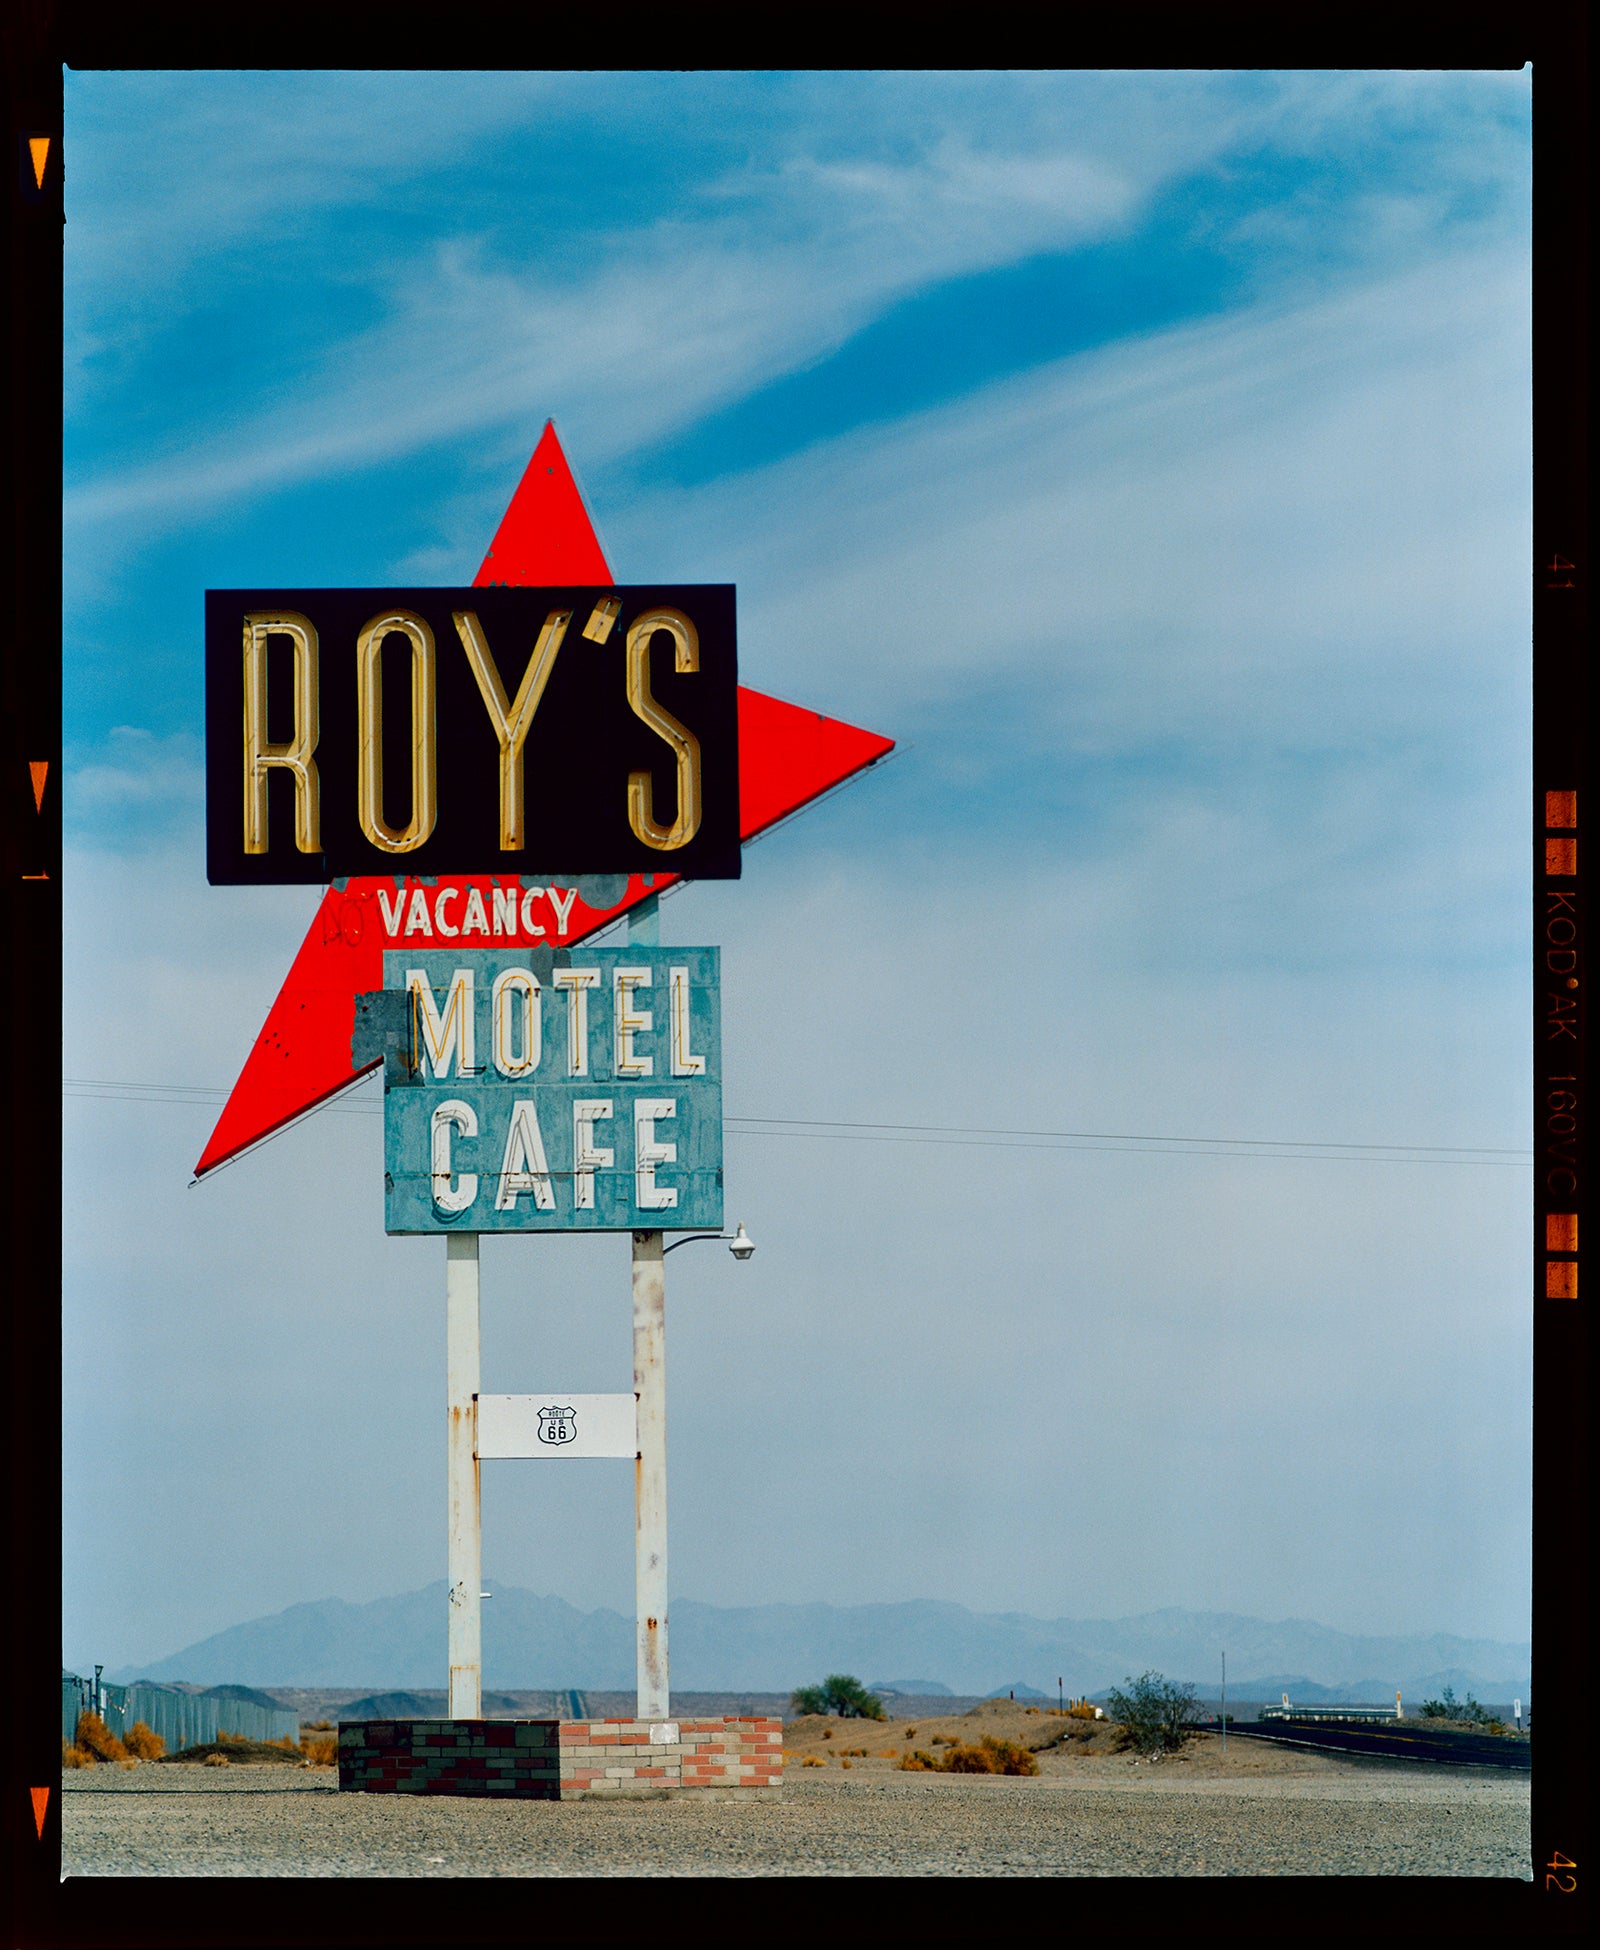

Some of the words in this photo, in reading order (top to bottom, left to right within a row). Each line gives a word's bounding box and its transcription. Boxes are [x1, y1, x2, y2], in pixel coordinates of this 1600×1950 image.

[243, 595, 701, 854] ROY'S
[377, 886, 578, 937] VACANCY
[405, 966, 707, 1079] MOTEL
[431, 1098, 679, 1212] CAFE
[1546, 1072, 1577, 1196] 160VC
[548, 1426, 566, 1440] 66
[1545, 1850, 1578, 1893] 42
